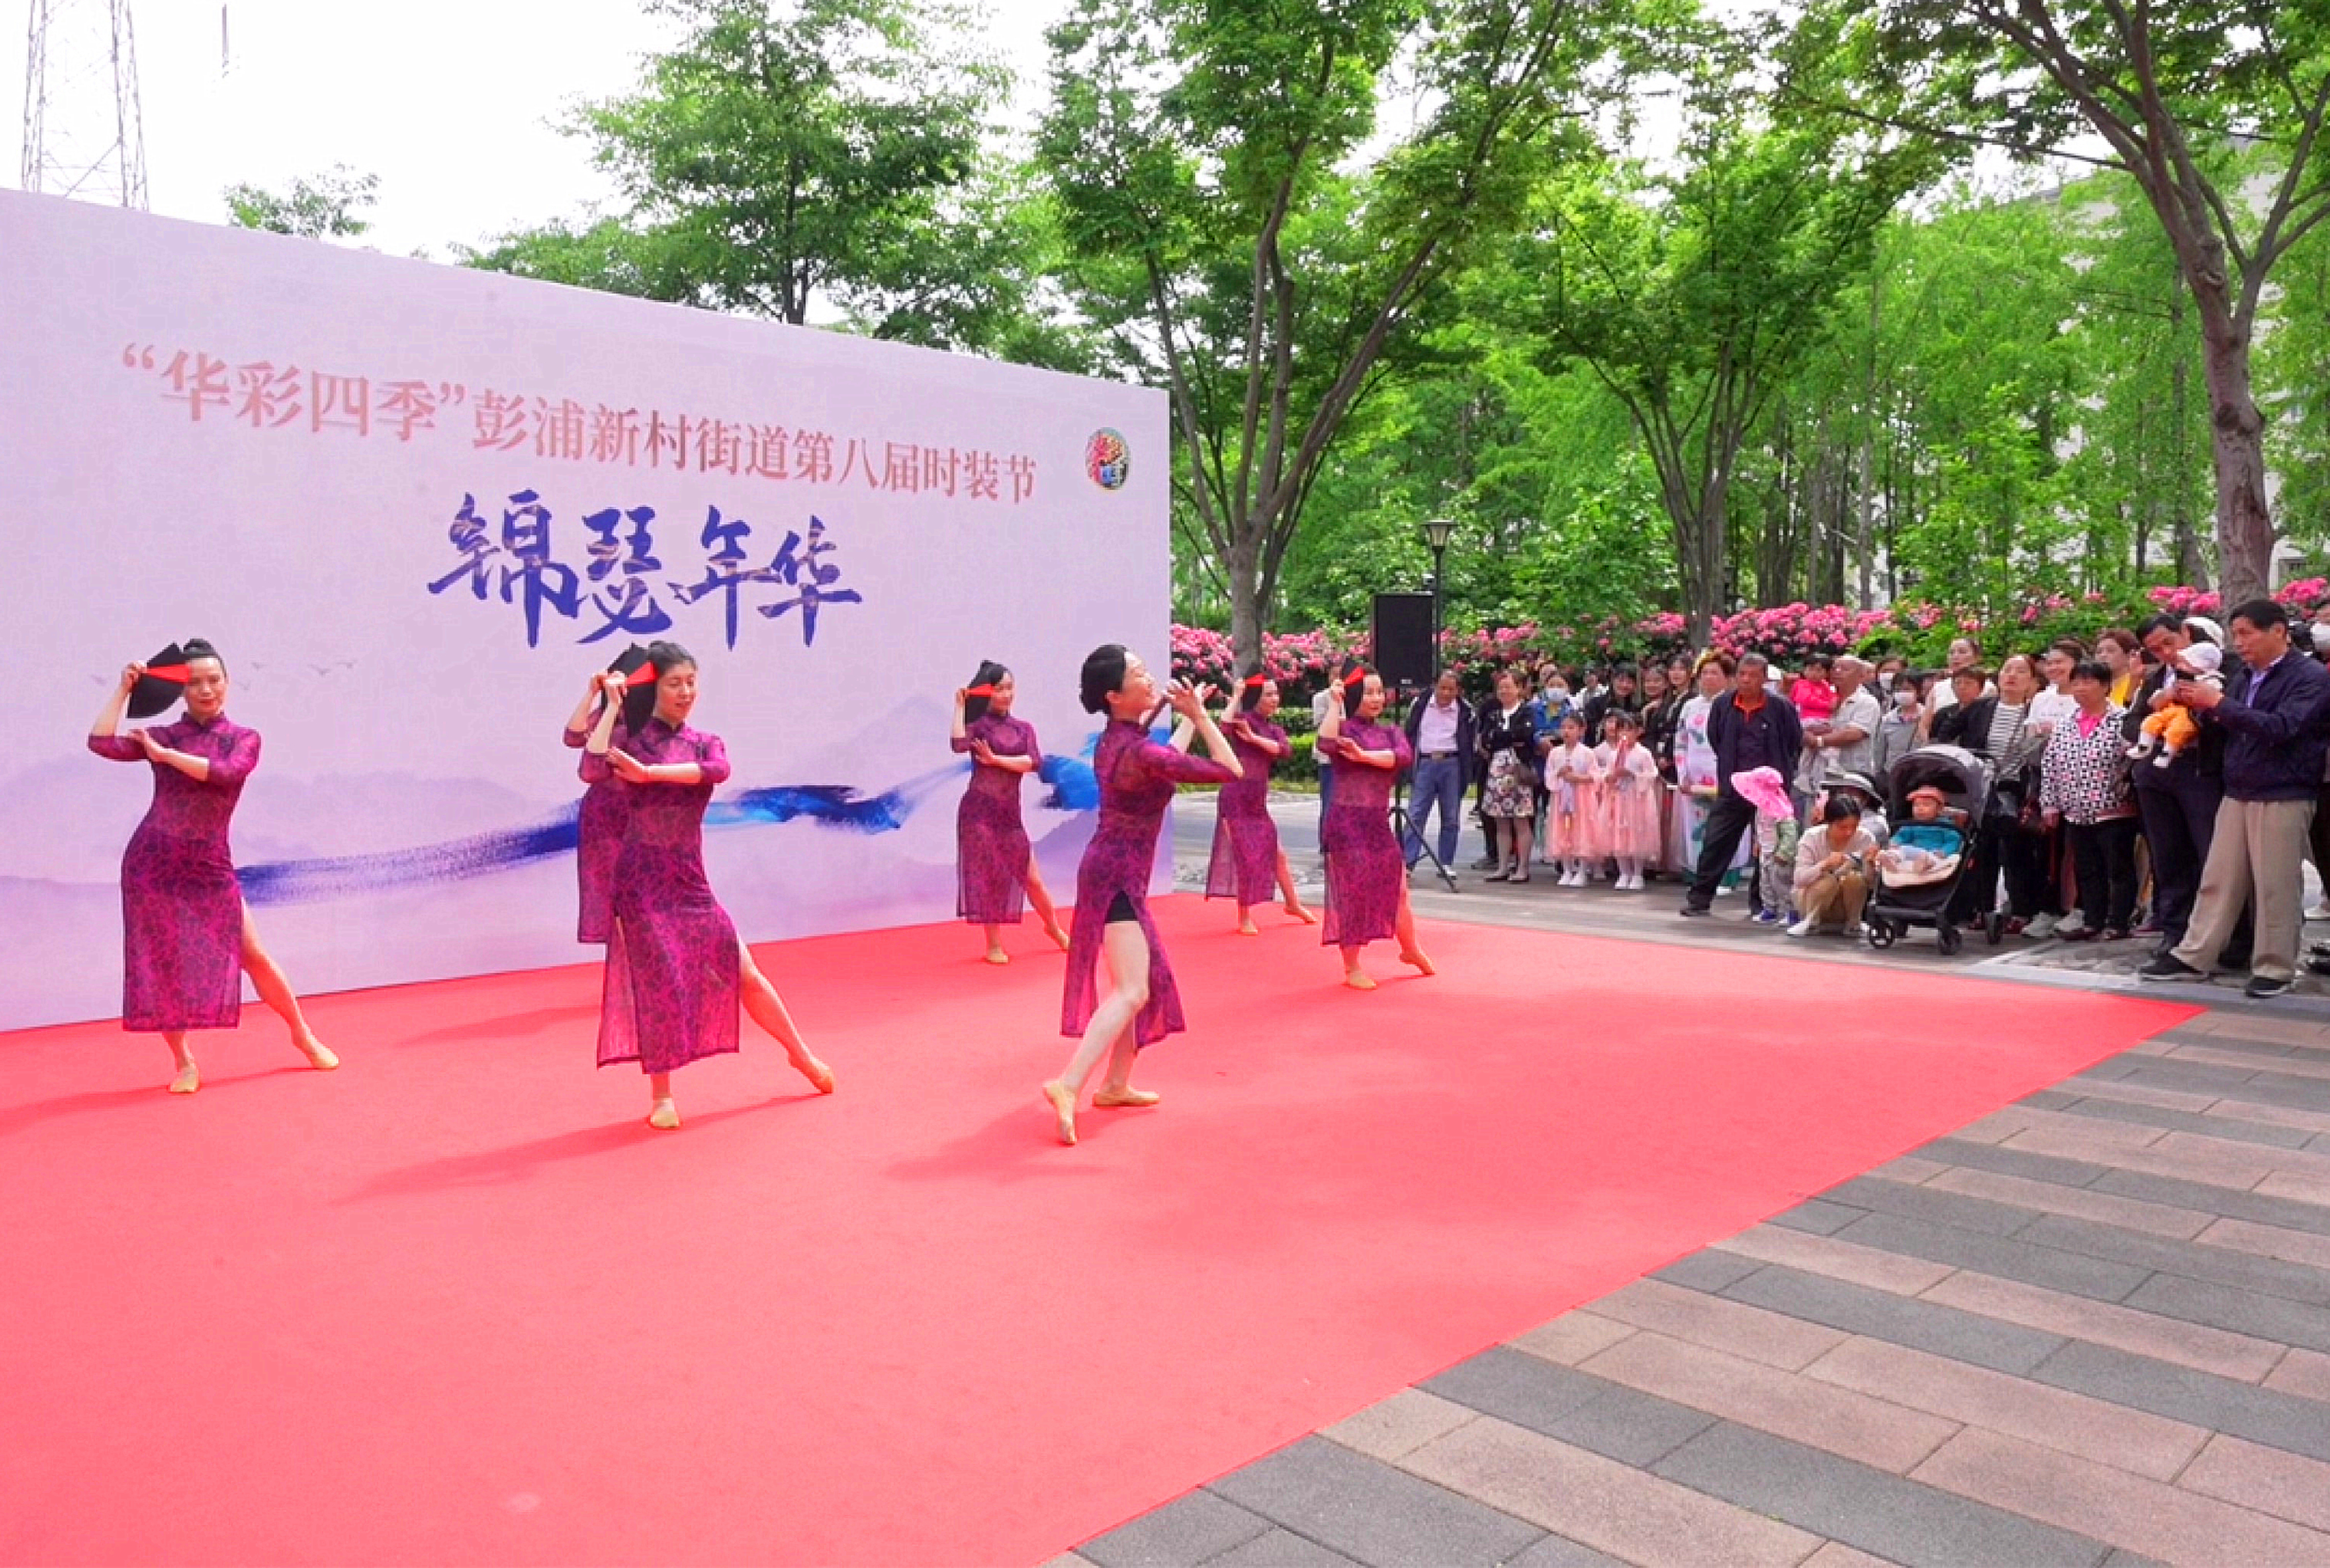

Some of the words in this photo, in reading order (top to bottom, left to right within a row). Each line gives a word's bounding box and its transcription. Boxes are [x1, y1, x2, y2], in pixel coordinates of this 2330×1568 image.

[122, 342, 1036, 504] “华彩四季”彭浦新村街道第八届时装节
[427, 488, 862, 650] 锦瑟年华
